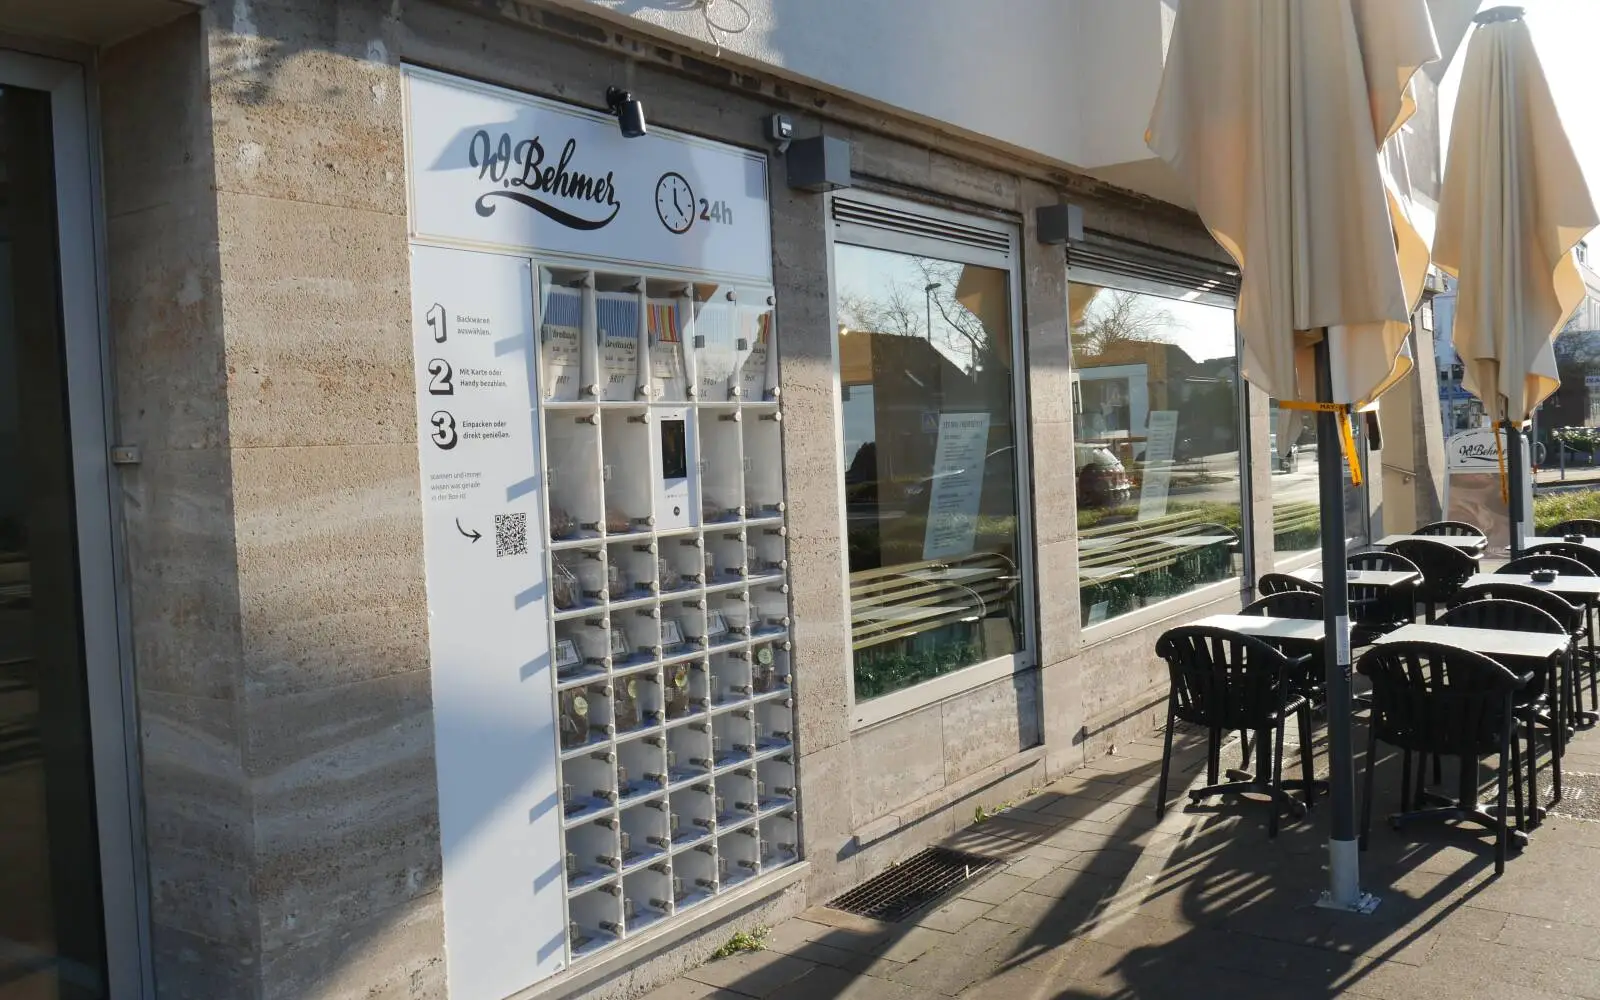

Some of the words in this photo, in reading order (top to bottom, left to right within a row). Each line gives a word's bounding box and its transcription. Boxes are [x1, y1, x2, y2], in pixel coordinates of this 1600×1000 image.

[699, 198, 733, 225] 24h
[426, 302, 447, 344] 1
[456, 315, 490, 324] Backwaren
[459, 368, 469, 376] Mit
[471, 368, 488, 376] Karte
[488, 368, 502, 376] oder
[428, 358, 454, 396] 2
[460, 380, 479, 388] Handy
[462, 420, 492, 429] Einpacken
[493, 420, 507, 428] oder
[431, 410, 458, 450] 3
[462, 432, 481, 440] direkt
